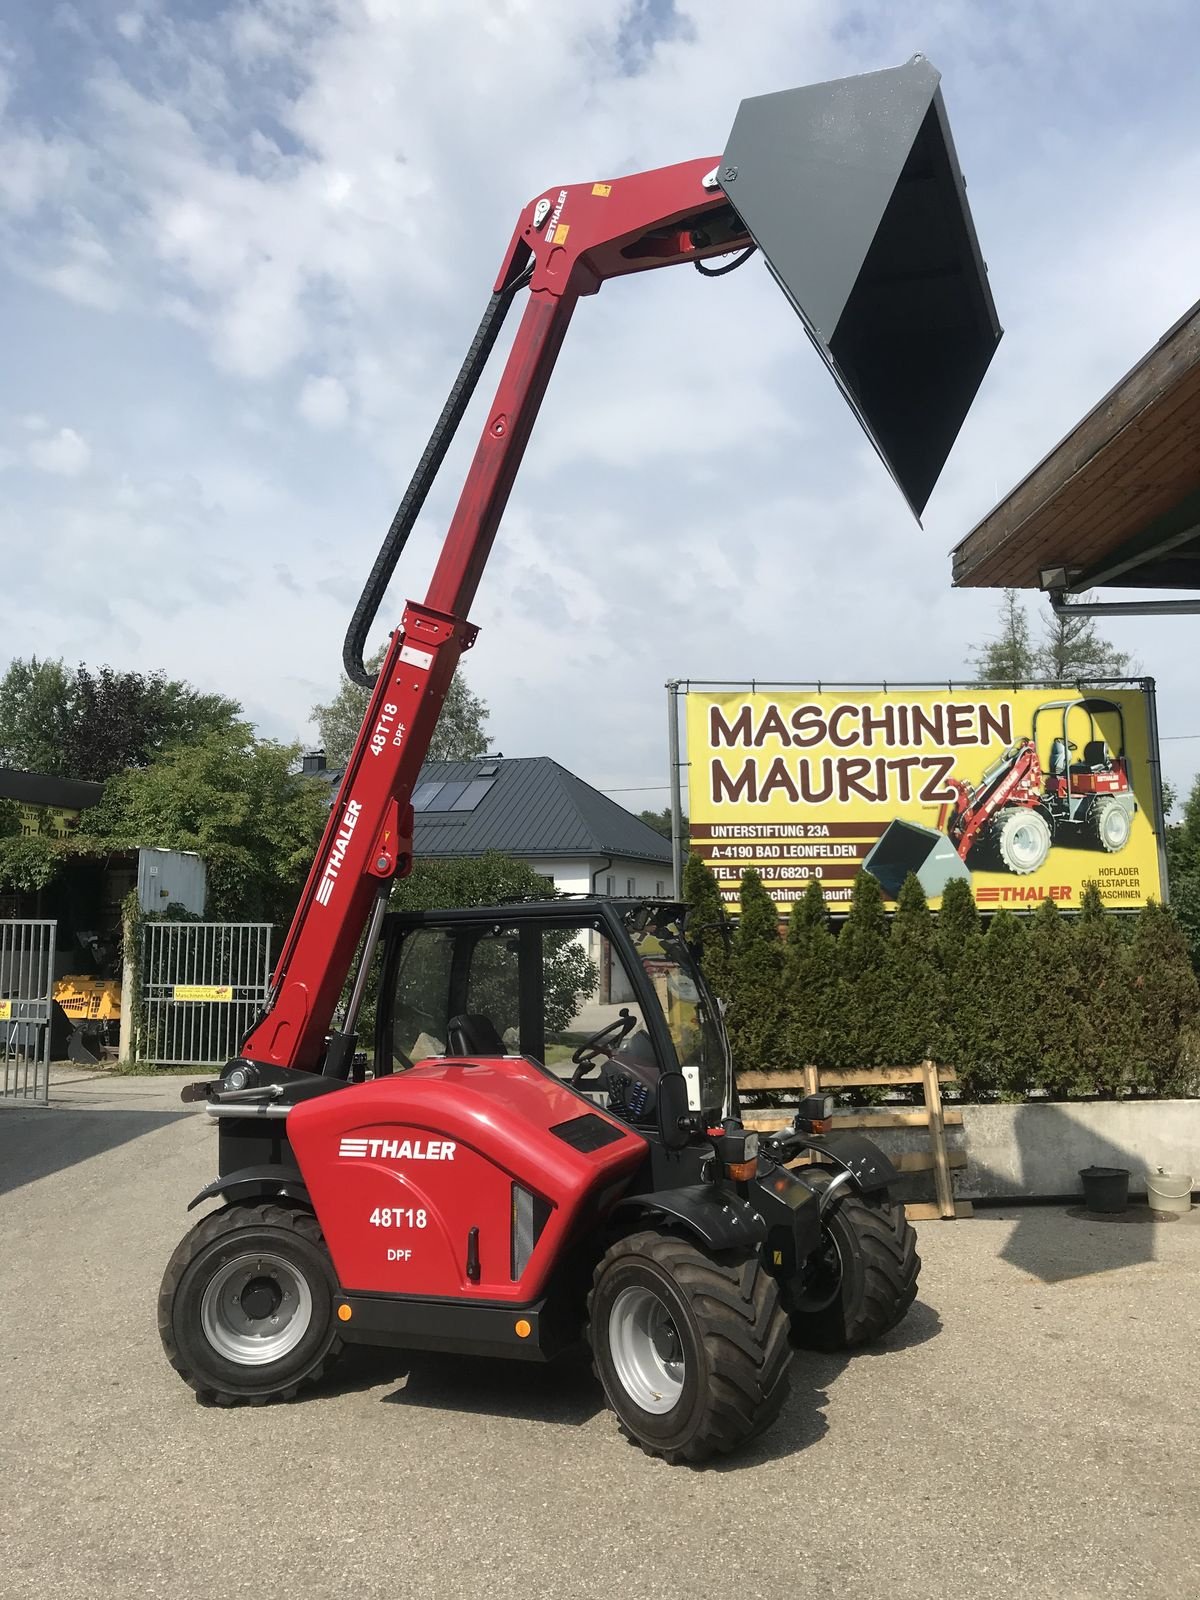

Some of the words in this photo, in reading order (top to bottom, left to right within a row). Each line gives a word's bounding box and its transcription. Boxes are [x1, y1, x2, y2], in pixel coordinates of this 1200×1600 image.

[549, 190, 568, 231] THALER
[370, 703, 398, 757] 48T18
[392, 722, 406, 747] DPF
[710, 704, 1012, 747] MASCHINEN
[711, 756, 957, 802] MAURITZ
[324, 799, 363, 880] THALER
[711, 825, 804, 838] UNTERSTIFTUNG
[807, 825, 830, 837] 23A
[711, 846, 753, 858] A-4190
[755, 846, 780, 858] BAD
[783, 845, 857, 857] LEONFELDEN
[712, 867, 737, 879] TEL:
[1098, 867, 1139, 876] HOFLADER
[1001, 886, 1072, 901] THALER
[368, 1139, 457, 1161] THALER
[369, 1207, 428, 1229] 48T18
[387, 1249, 412, 1261] DPF
